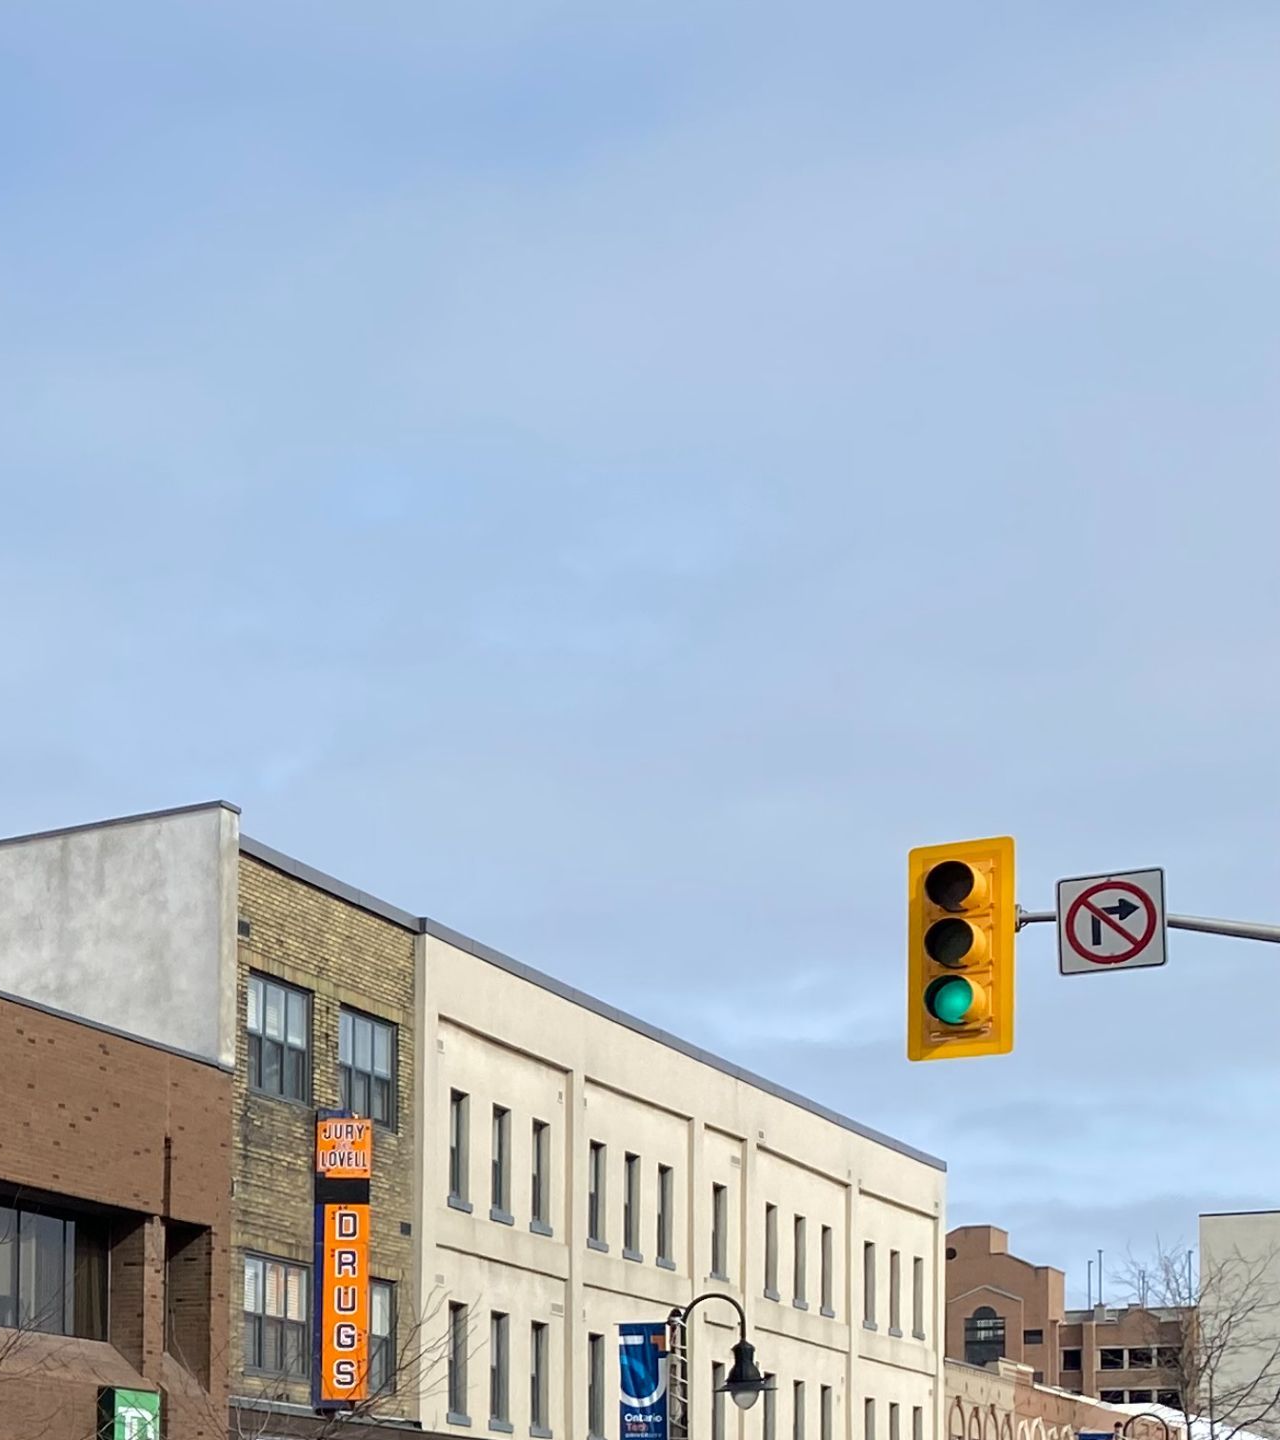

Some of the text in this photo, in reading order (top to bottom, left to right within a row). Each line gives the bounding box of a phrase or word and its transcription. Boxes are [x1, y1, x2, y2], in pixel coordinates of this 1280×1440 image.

[323, 1123, 365, 1140] JURY
[320, 1150, 368, 1168] LOVELL
[333, 1210, 359, 1389] DRUGS
[624, 1413, 663, 1423] Ontario
